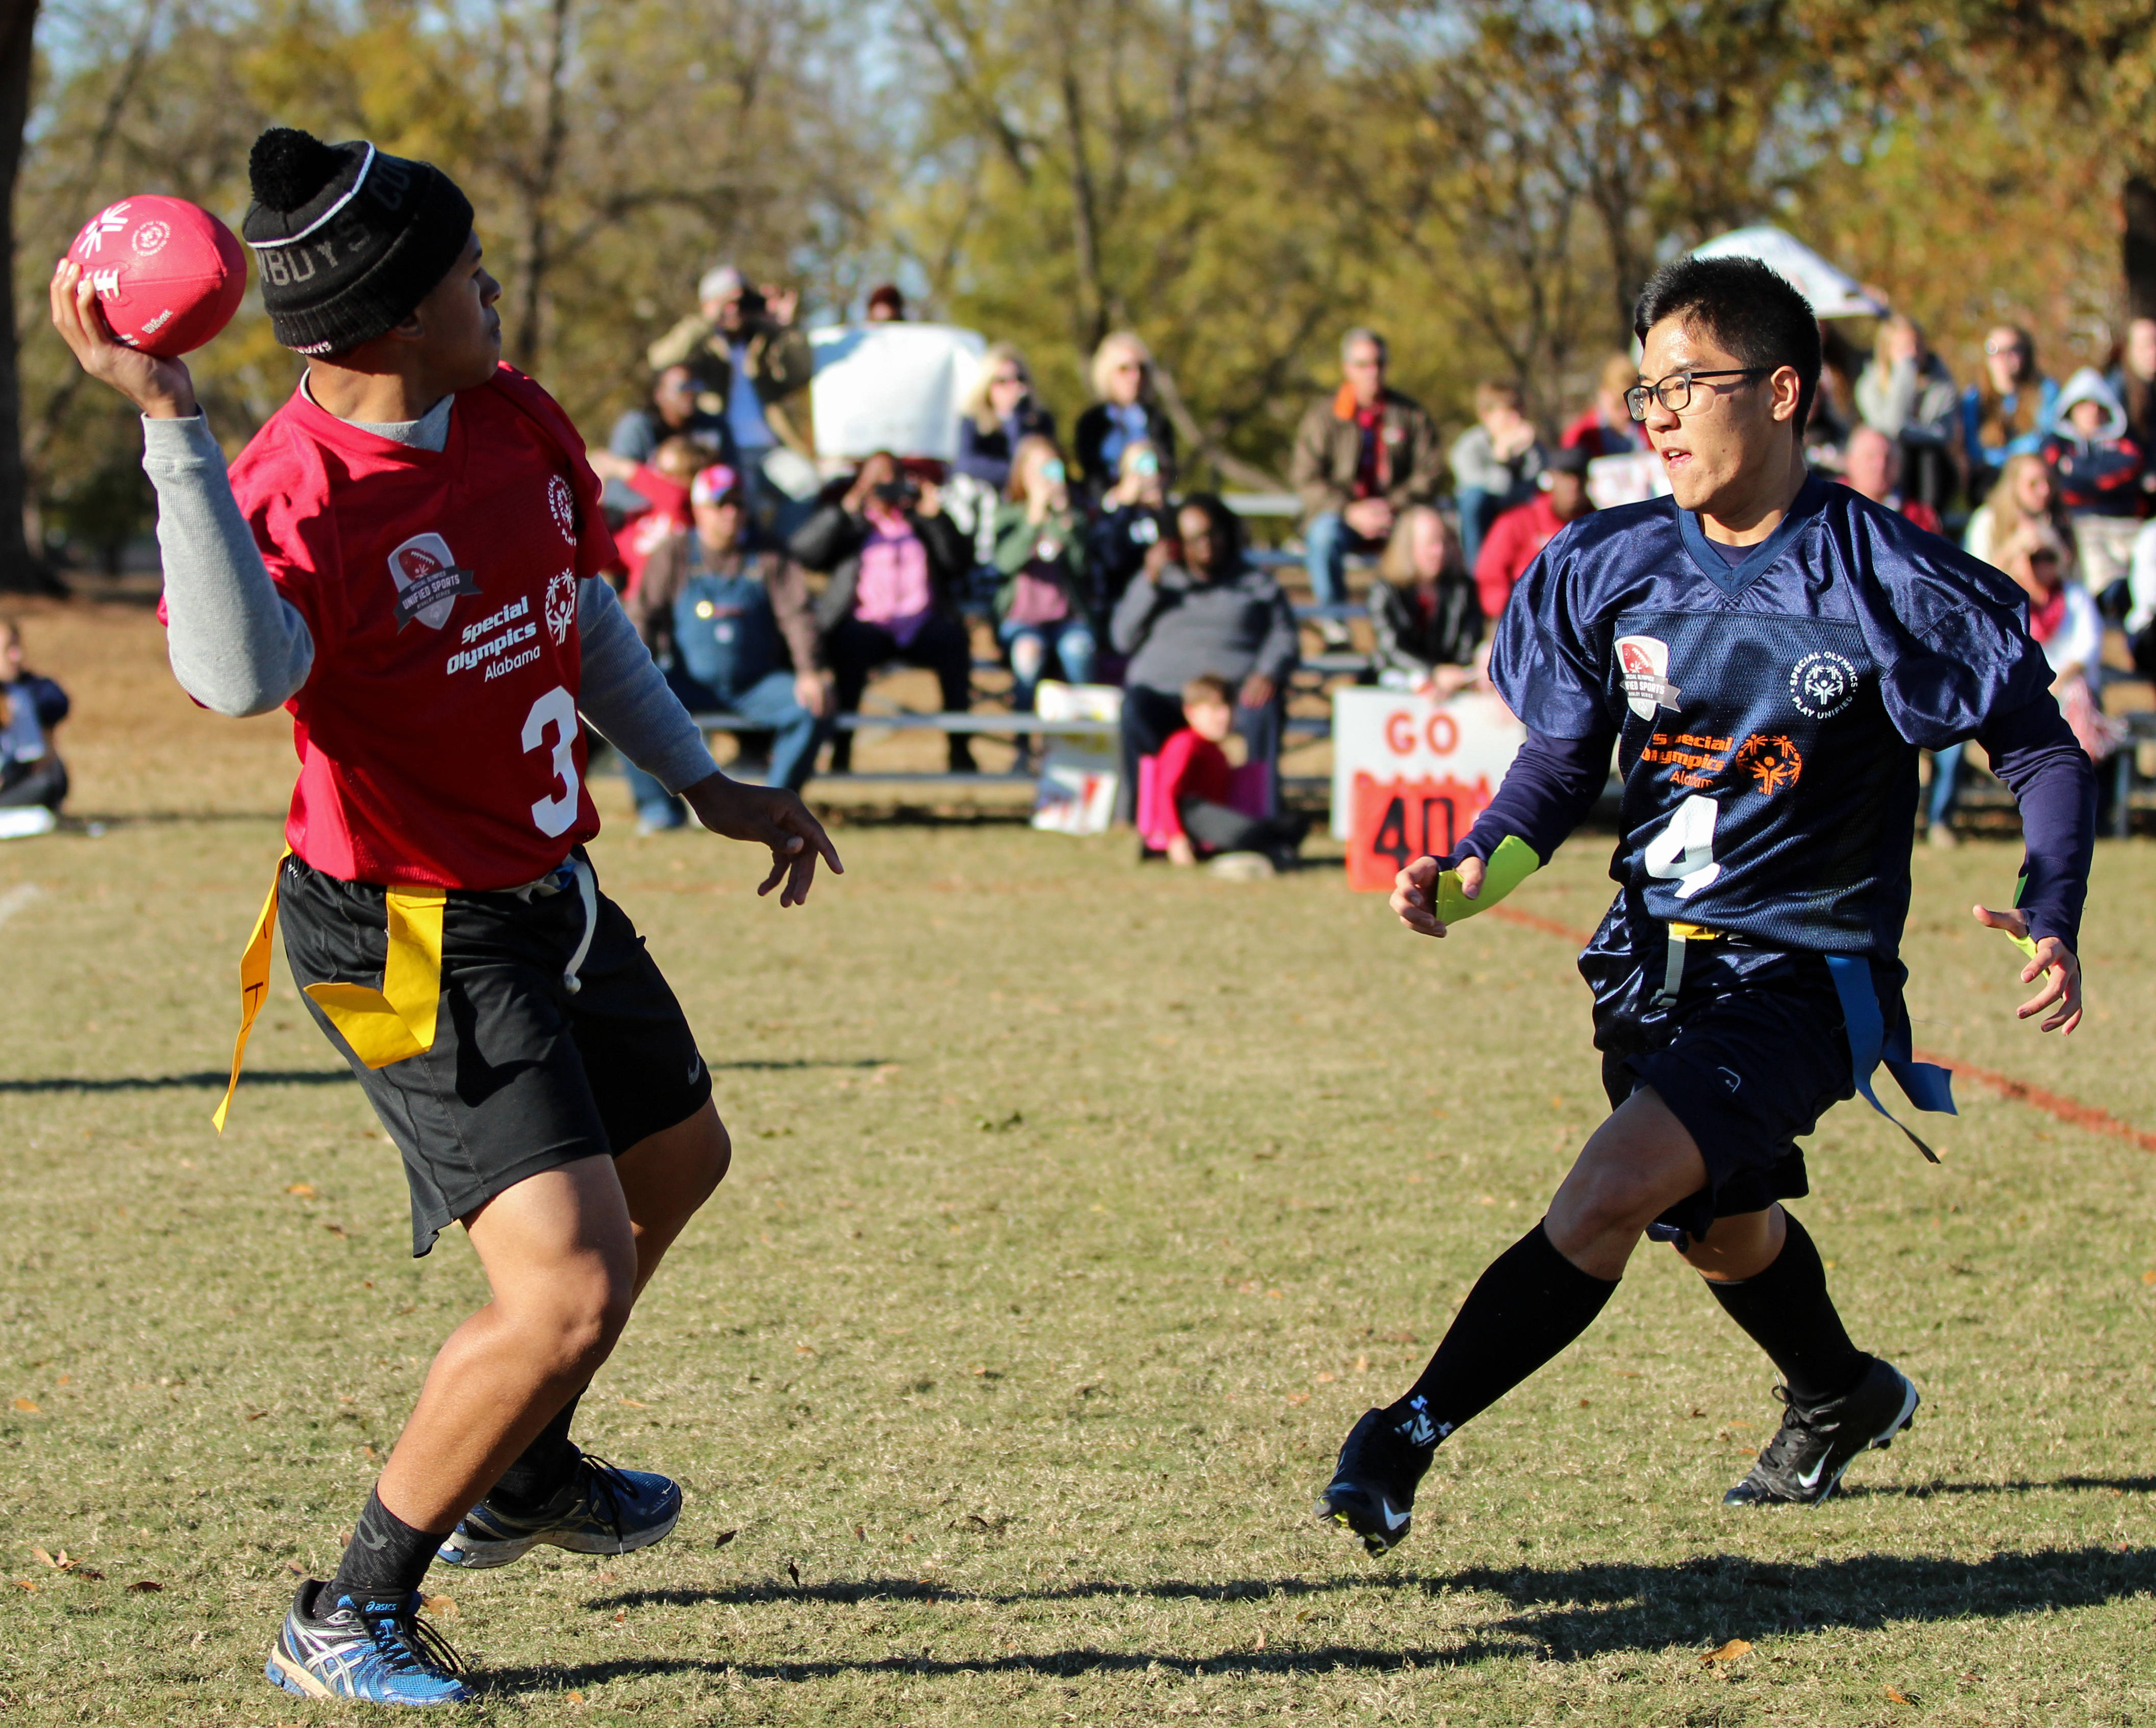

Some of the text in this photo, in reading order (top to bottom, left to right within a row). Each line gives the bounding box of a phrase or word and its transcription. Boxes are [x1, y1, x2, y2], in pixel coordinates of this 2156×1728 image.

[402, 574, 461, 609] UNIFIED SPORTS
[461, 595, 529, 645] Special
[446, 622, 537, 675] Olympics
[485, 645, 541, 682] Alabama
[1789, 651, 1858, 688] SPECIAL OLYMPICS
[1639, 681, 1665, 695] SPORTS
[1792, 695, 1853, 720] PLAY UNIFIED
[1384, 708, 1461, 757] GO
[521, 685, 579, 837] 3
[1645, 795, 1721, 899] 4
